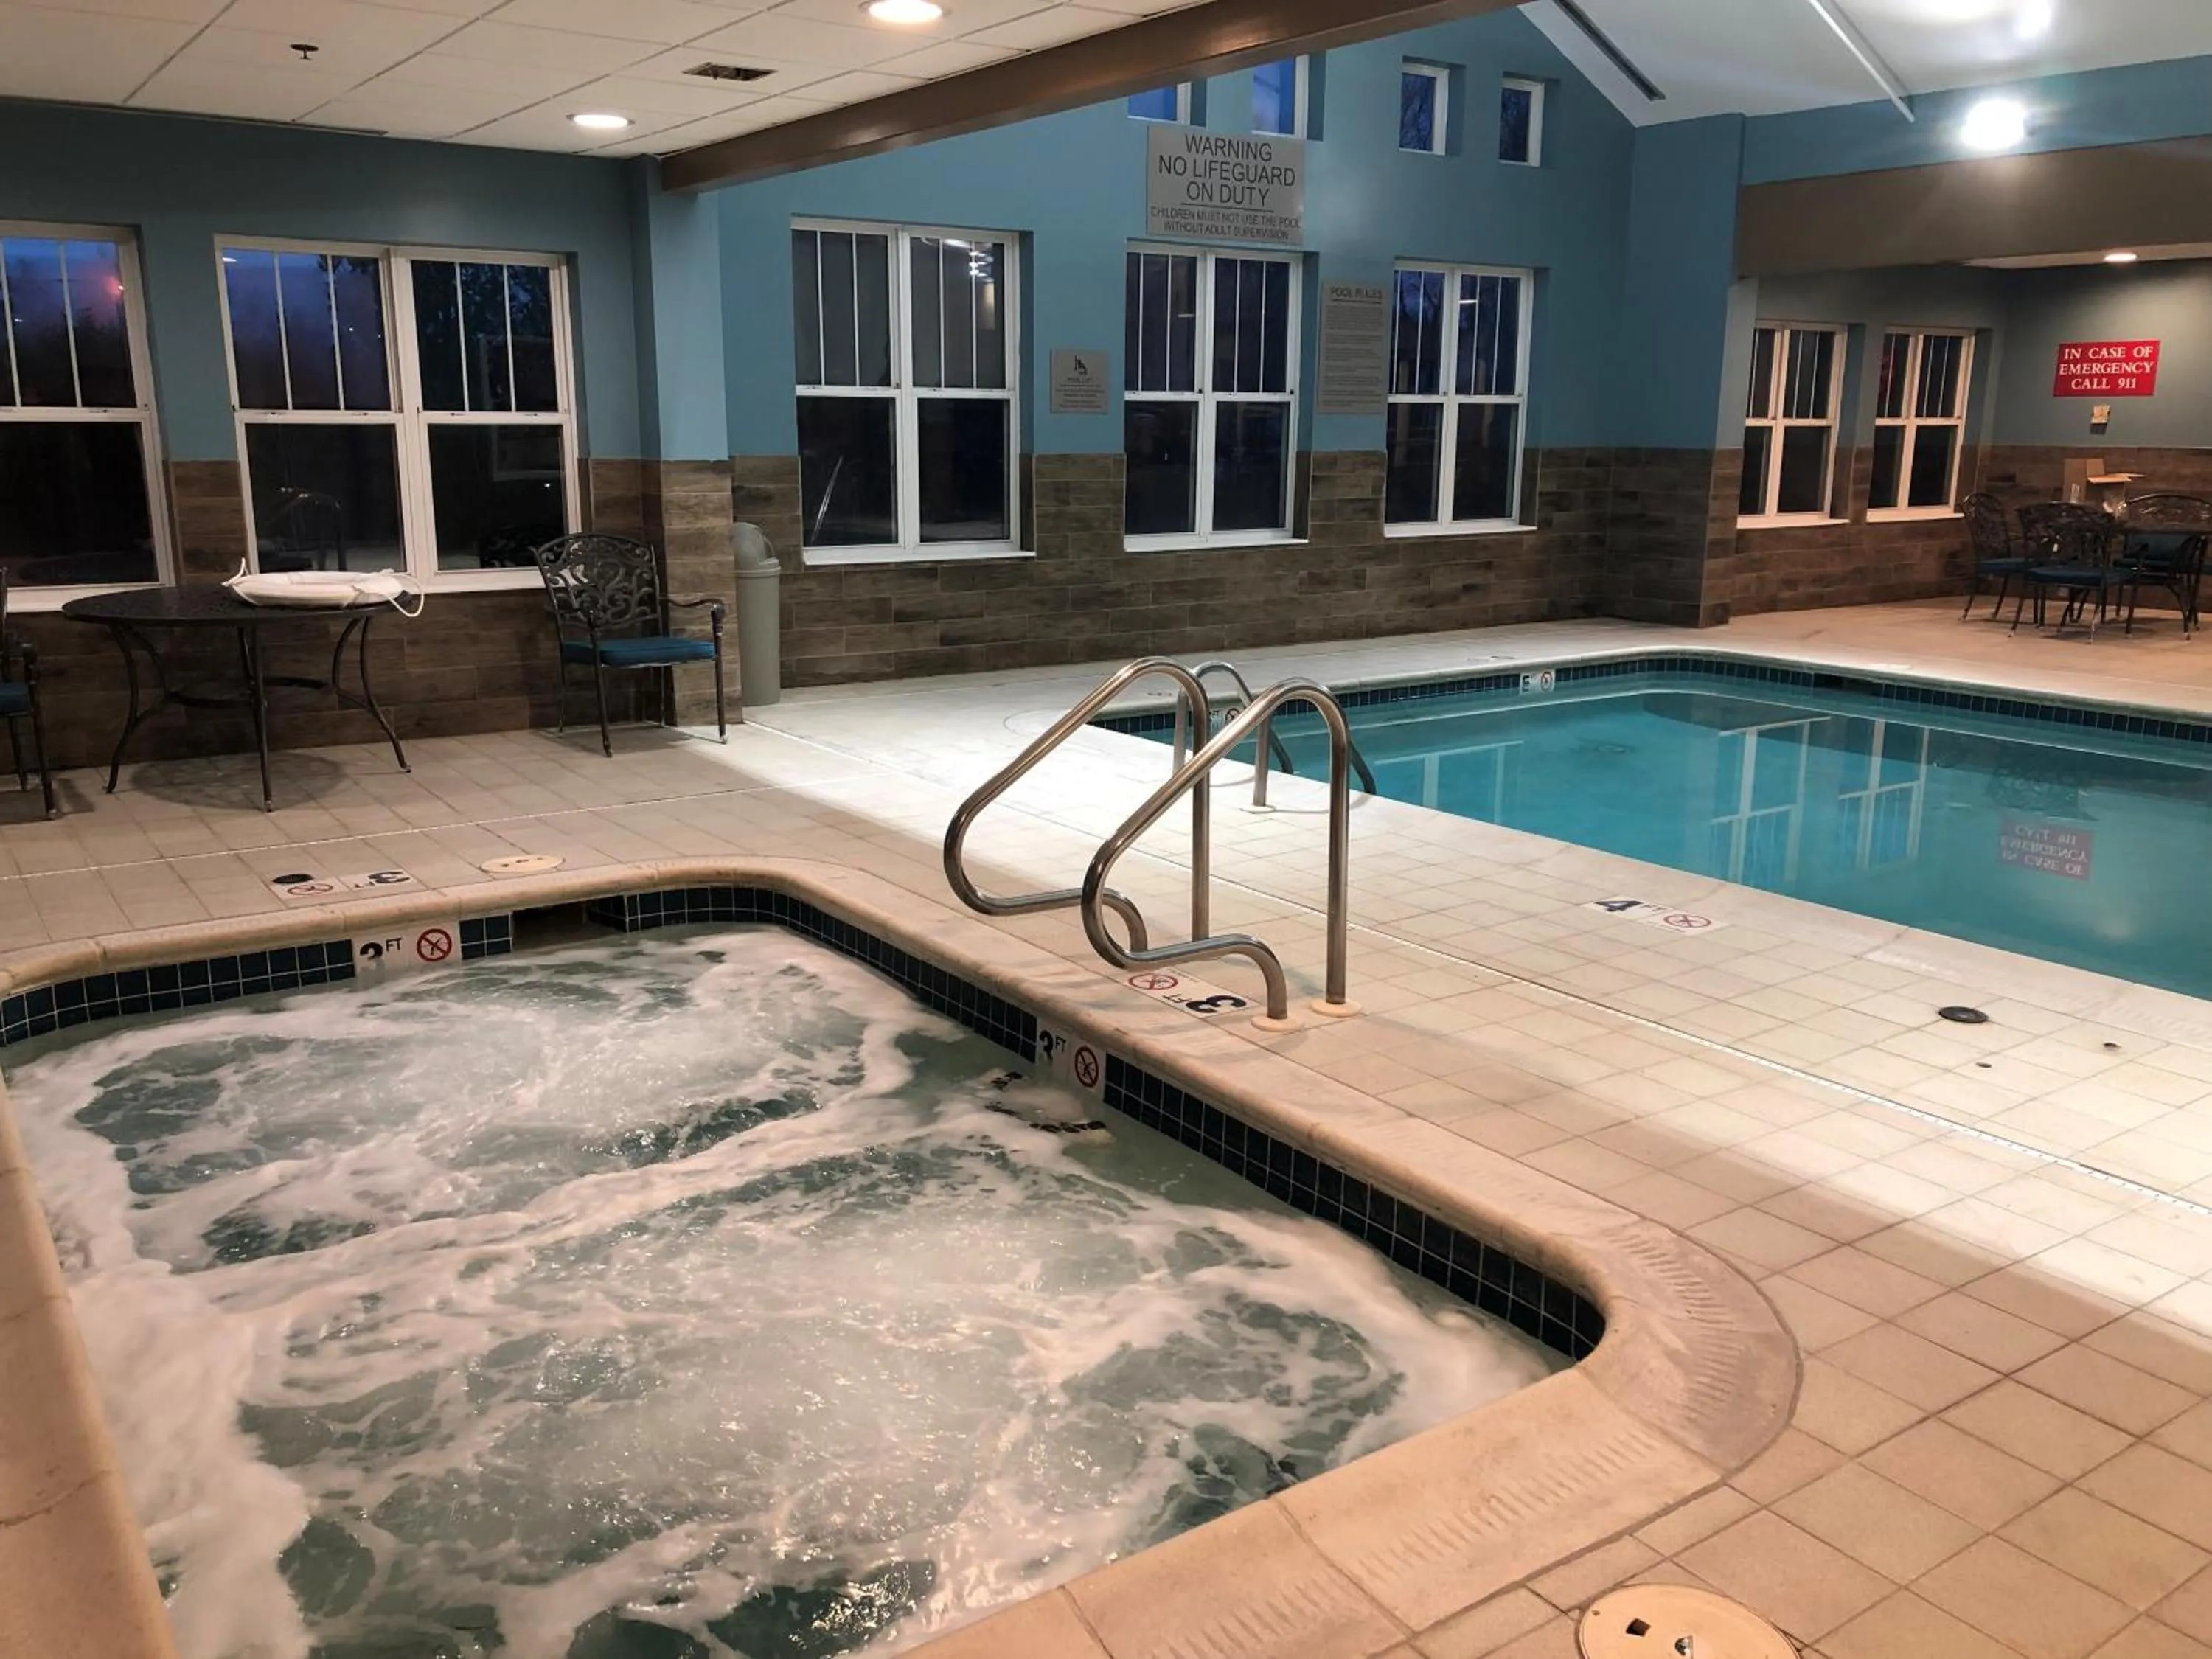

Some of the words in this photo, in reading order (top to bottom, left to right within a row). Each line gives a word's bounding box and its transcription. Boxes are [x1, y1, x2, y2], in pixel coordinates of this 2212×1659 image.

[1185, 133, 1273, 162] WARNING
[1158, 154, 1186, 177] NO
[1193, 159, 1295, 187] LIFEGUARD
[1186, 181, 1214, 202] ON
[1219, 184, 1270, 207] DUTY
[1151, 206, 1195, 220] CHILDREN
[1164, 220, 1203, 234] WITHOUT
[1205, 223, 1232, 237] ADULT
[2064, 348, 2081, 360] IN
[2088, 347, 2126, 359] CASE
[2132, 346, 2154, 358] OF
[2059, 361, 2154, 375] EMERGENCY
[2071, 378, 2111, 390] CALL
[2118, 378, 2137, 389] 911
[1595, 900, 1643, 912] 4
[386, 938, 402, 951] FT
[1186, 995, 1247, 1013] 3
[1055, 1035, 1066, 1052] FT
